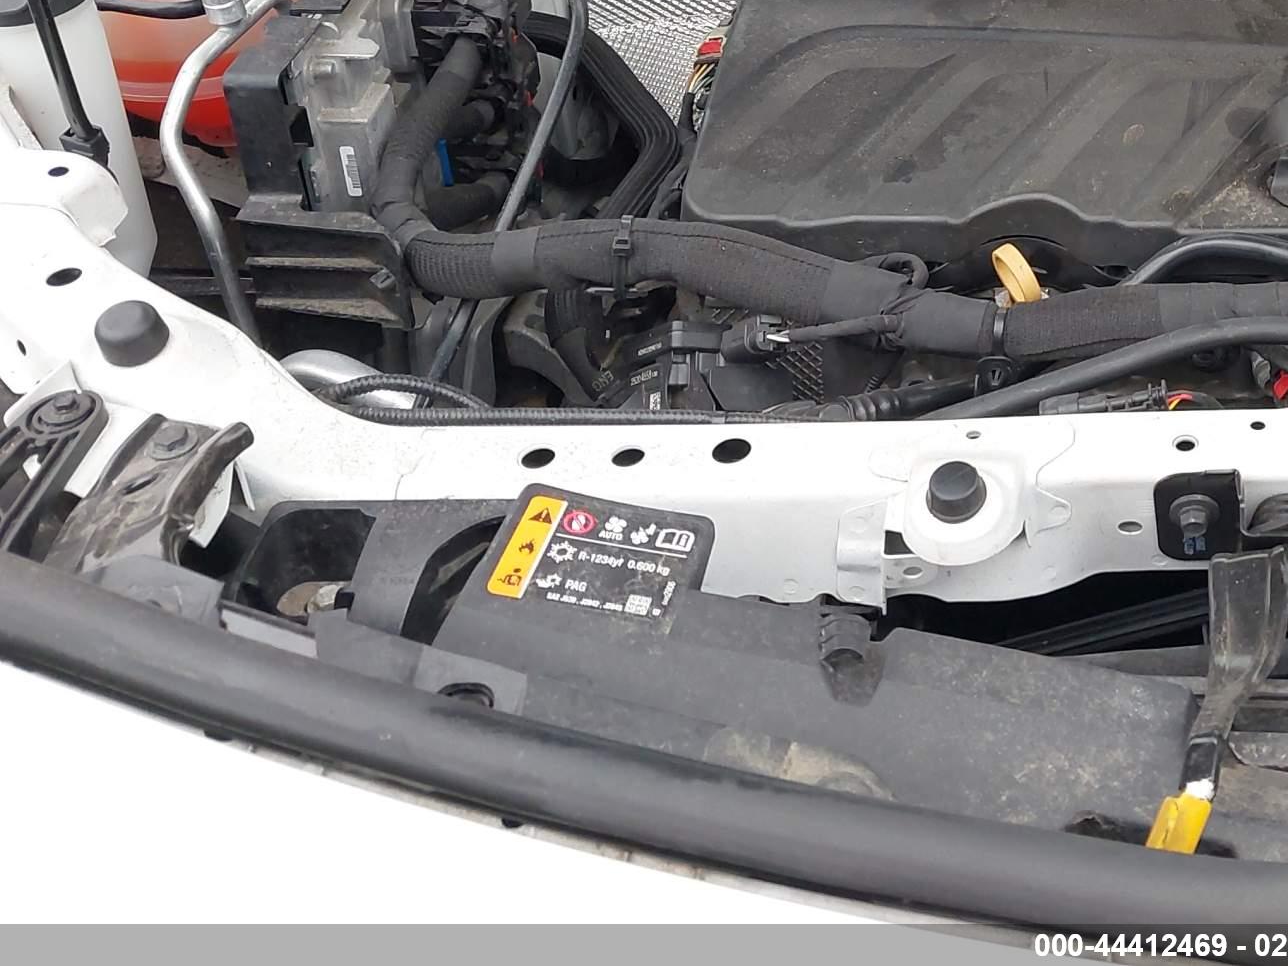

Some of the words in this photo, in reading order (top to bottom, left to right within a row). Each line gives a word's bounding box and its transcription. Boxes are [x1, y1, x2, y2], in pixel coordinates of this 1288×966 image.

[598, 530, 623, 541] AUTO
[577, 550, 625, 568] R-1234yf
[627, 560, 656, 573] 0.600
[656, 563, 671, 577] kg
[564, 579, 588, 592] PAG
